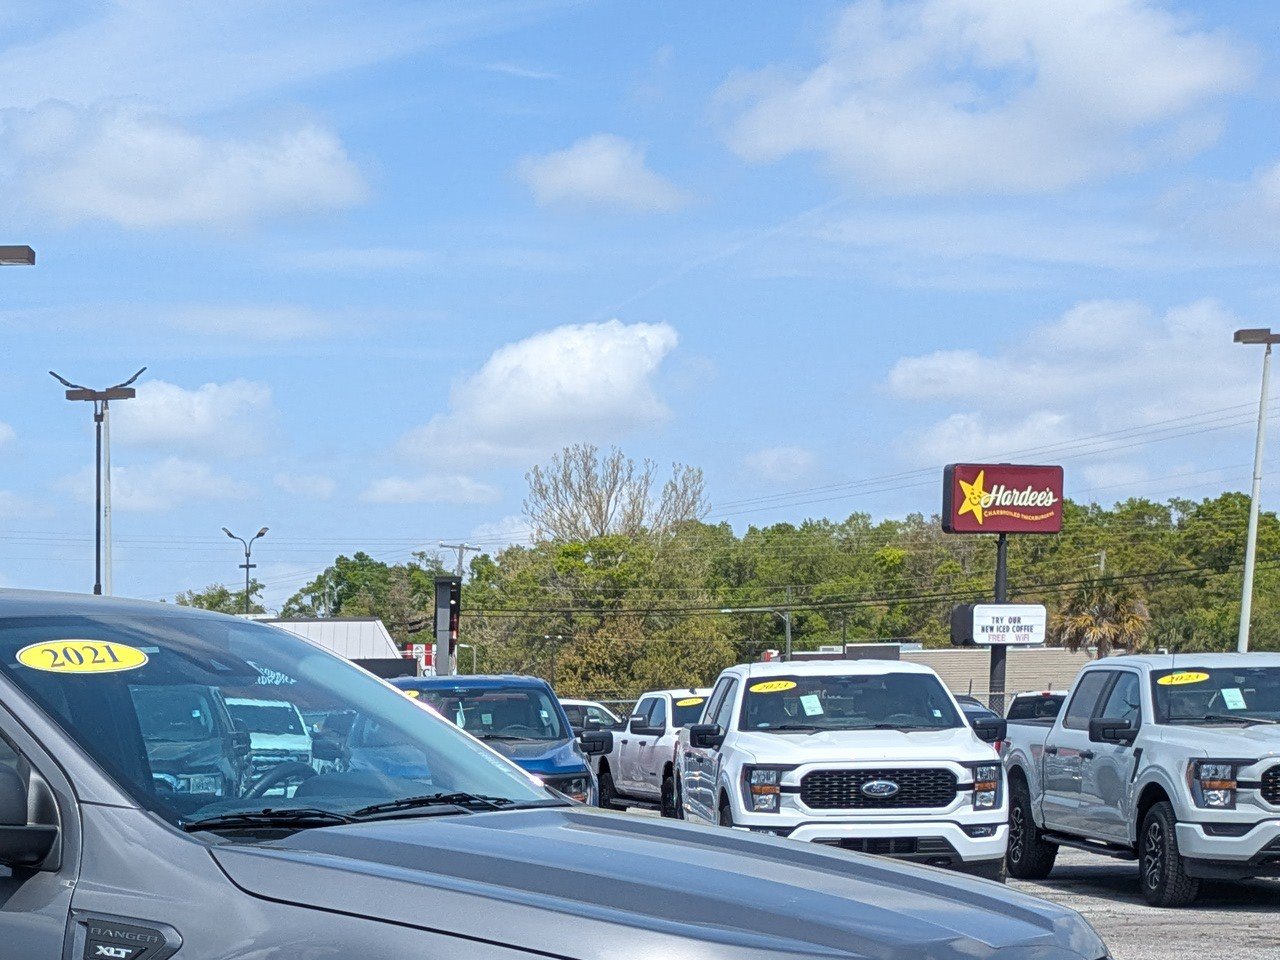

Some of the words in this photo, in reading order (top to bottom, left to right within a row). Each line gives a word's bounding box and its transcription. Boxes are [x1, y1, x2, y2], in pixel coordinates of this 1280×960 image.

[980, 484, 1058, 508] Hardee's
[991, 616, 1004, 624] TRY
[1008, 616, 1022, 624] OUR
[981, 625, 995, 633] NEW
[996, 625, 1010, 633] ICED
[1011, 625, 1034, 633] COFFEE
[988, 633, 1006, 641] FREE
[41, 645, 123, 668] 2021
[90, 927, 159, 943] RANGER
[95, 945, 133, 959] XLT
